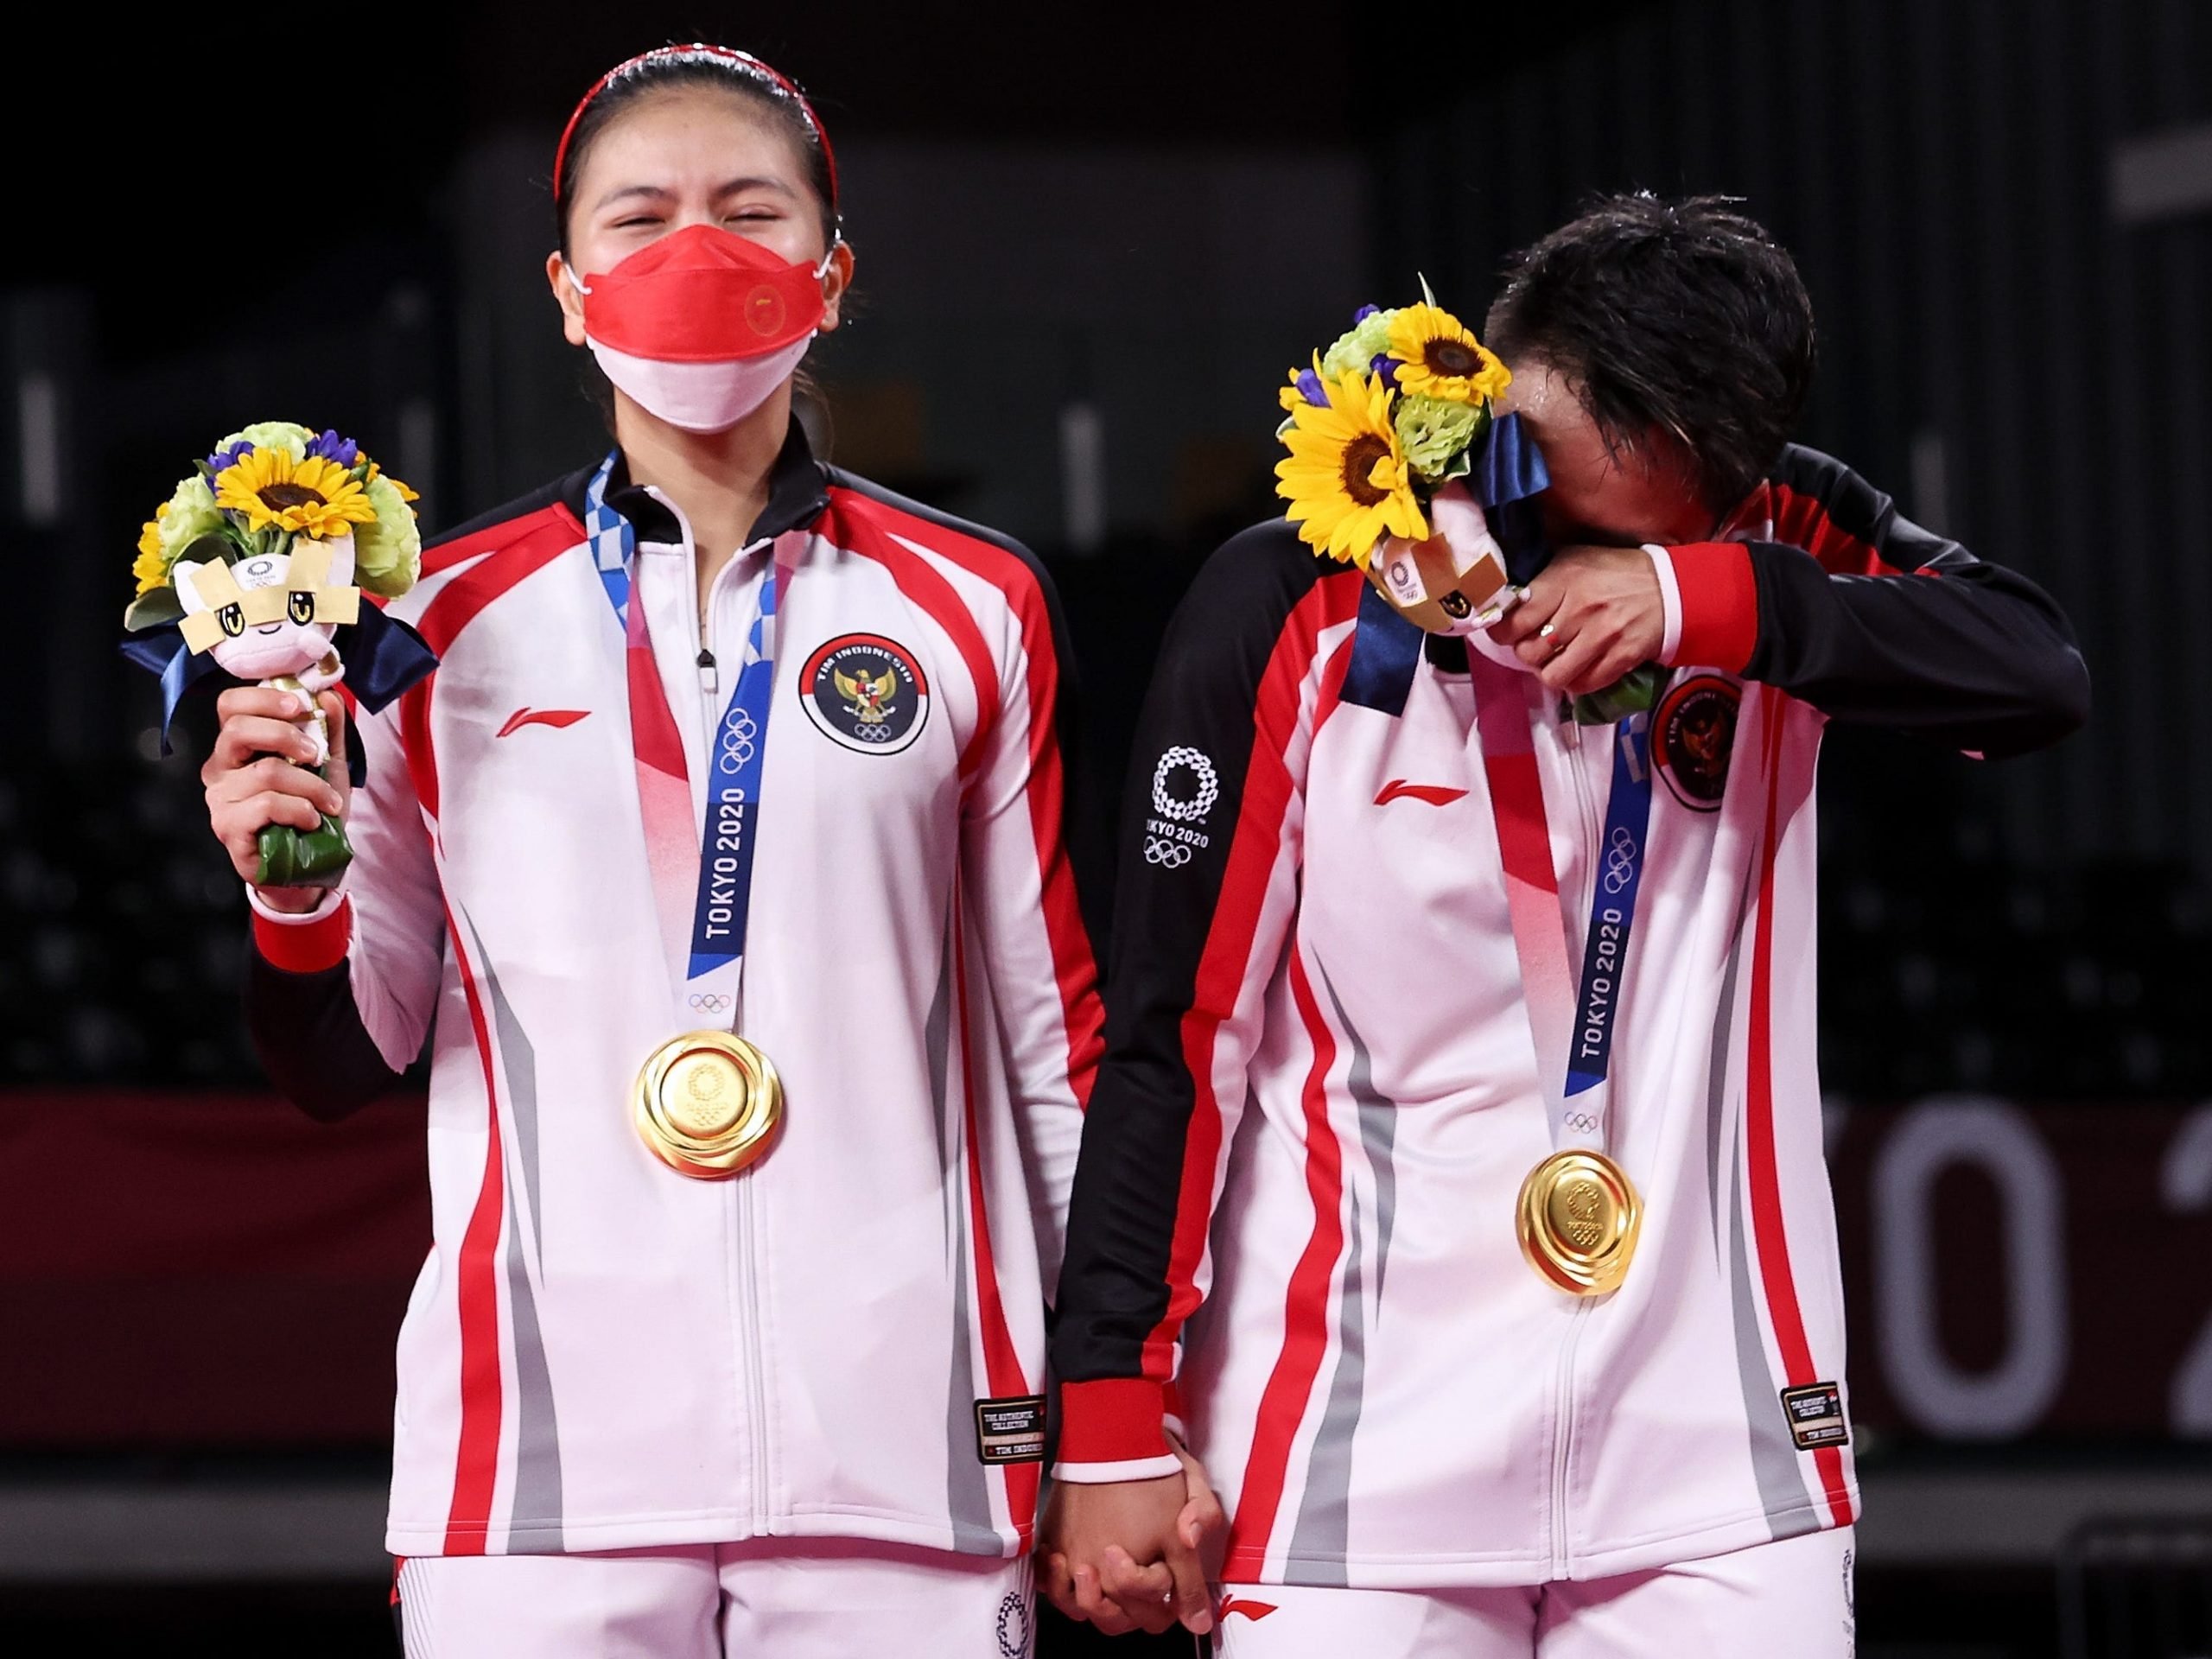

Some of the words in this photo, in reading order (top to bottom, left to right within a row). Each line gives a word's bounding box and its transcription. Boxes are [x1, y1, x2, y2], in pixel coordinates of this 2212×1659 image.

[817, 657, 836, 682] TIM
[836, 645, 914, 683] INDONESIA
[716, 787, 746, 852] 2020
[1175, 827, 1209, 849] 2020
[706, 857, 739, 939] TOKYO
[1581, 977, 1611, 1058] TOKYO
[1596, 908, 1623, 973] 2020
